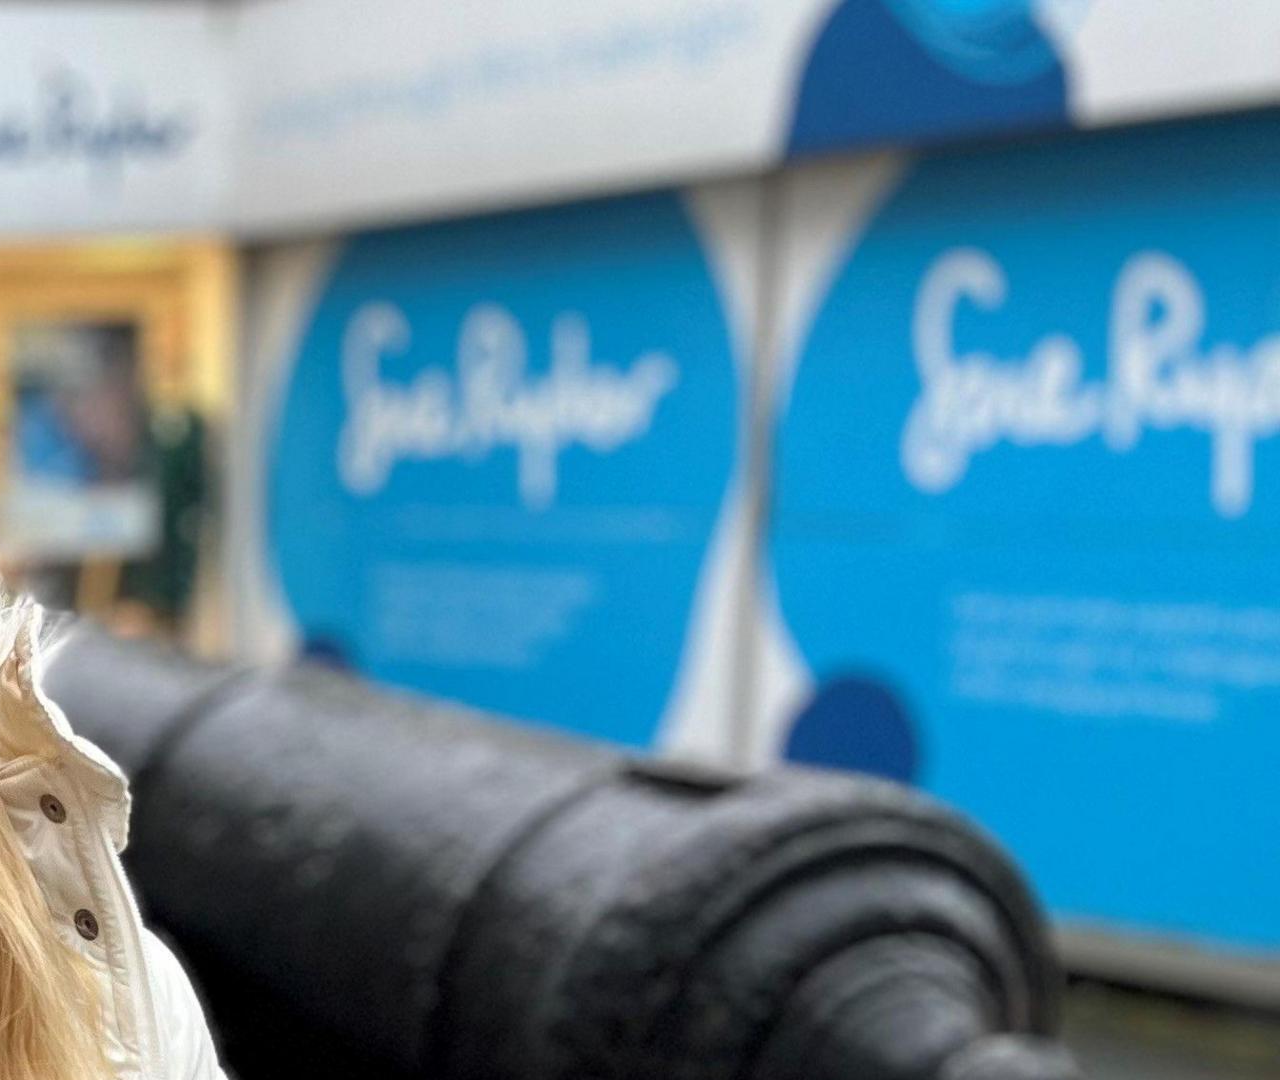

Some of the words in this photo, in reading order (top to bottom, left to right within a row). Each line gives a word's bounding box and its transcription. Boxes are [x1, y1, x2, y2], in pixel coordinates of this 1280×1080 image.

[338, 301, 454, 494] Sue
[457, 301, 678, 510] Ryder
[902, 246, 1100, 492] Sue
